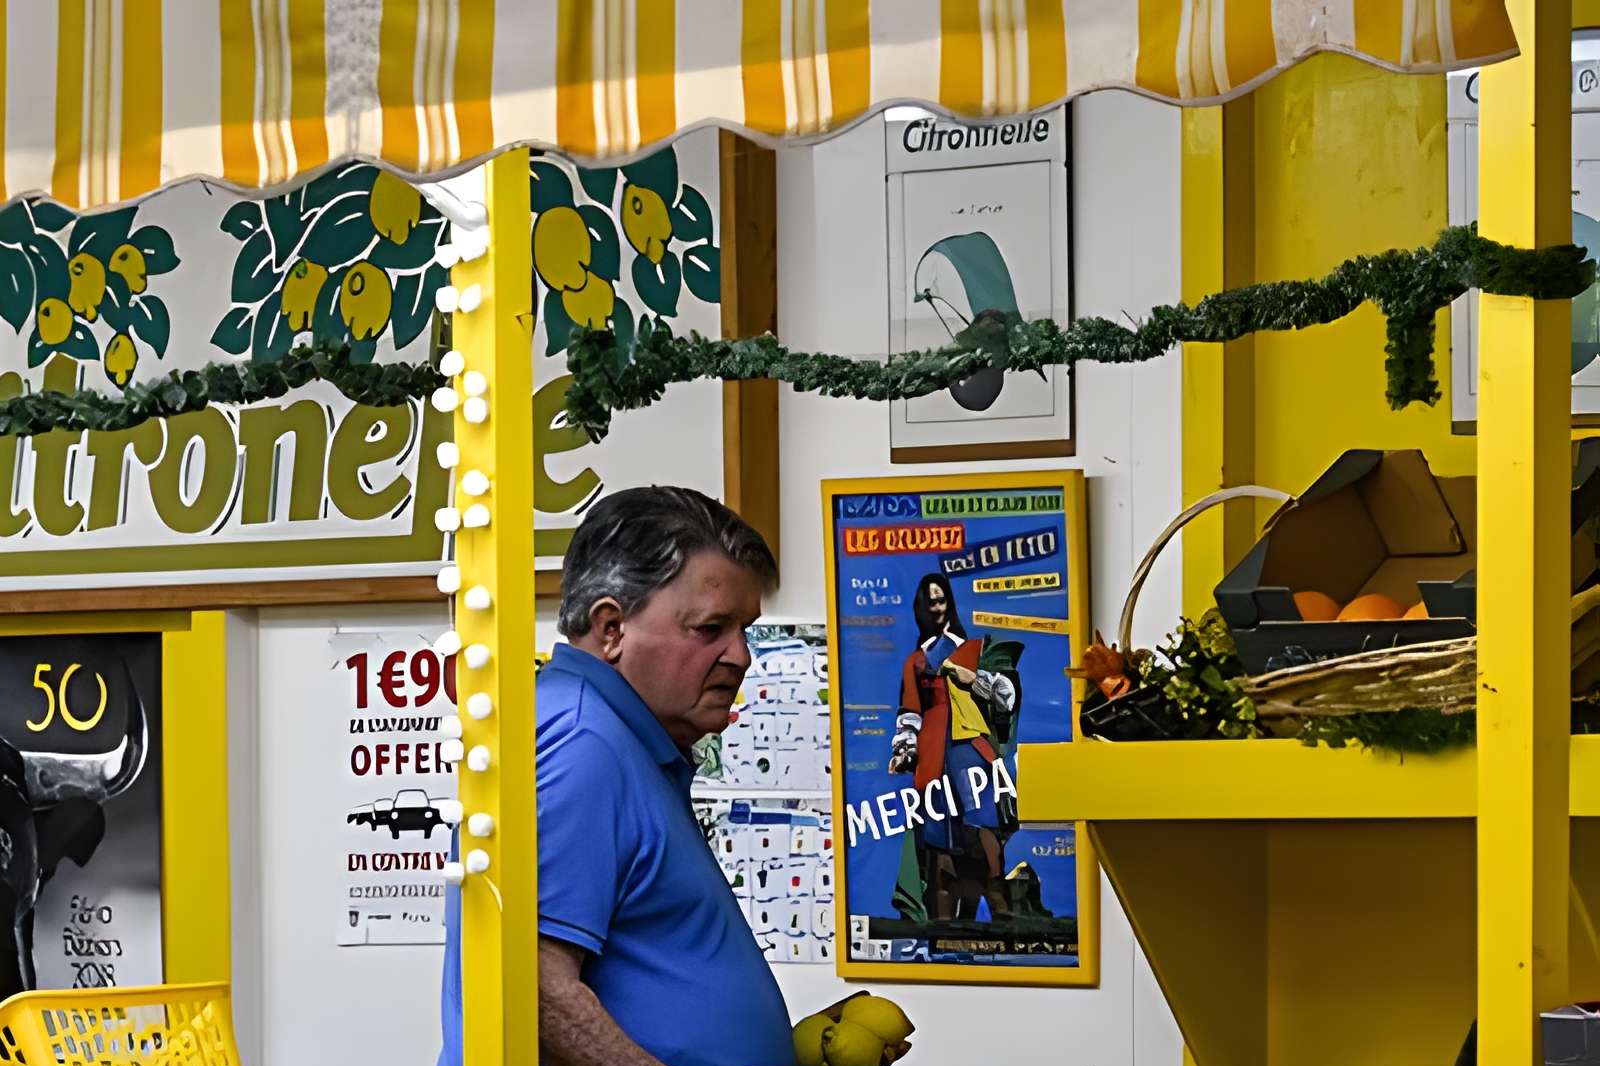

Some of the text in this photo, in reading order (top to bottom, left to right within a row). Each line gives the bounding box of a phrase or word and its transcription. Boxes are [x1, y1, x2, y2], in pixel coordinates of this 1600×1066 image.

[27, 663, 106, 731] 50
[846, 757, 1018, 847] MERCI PA
